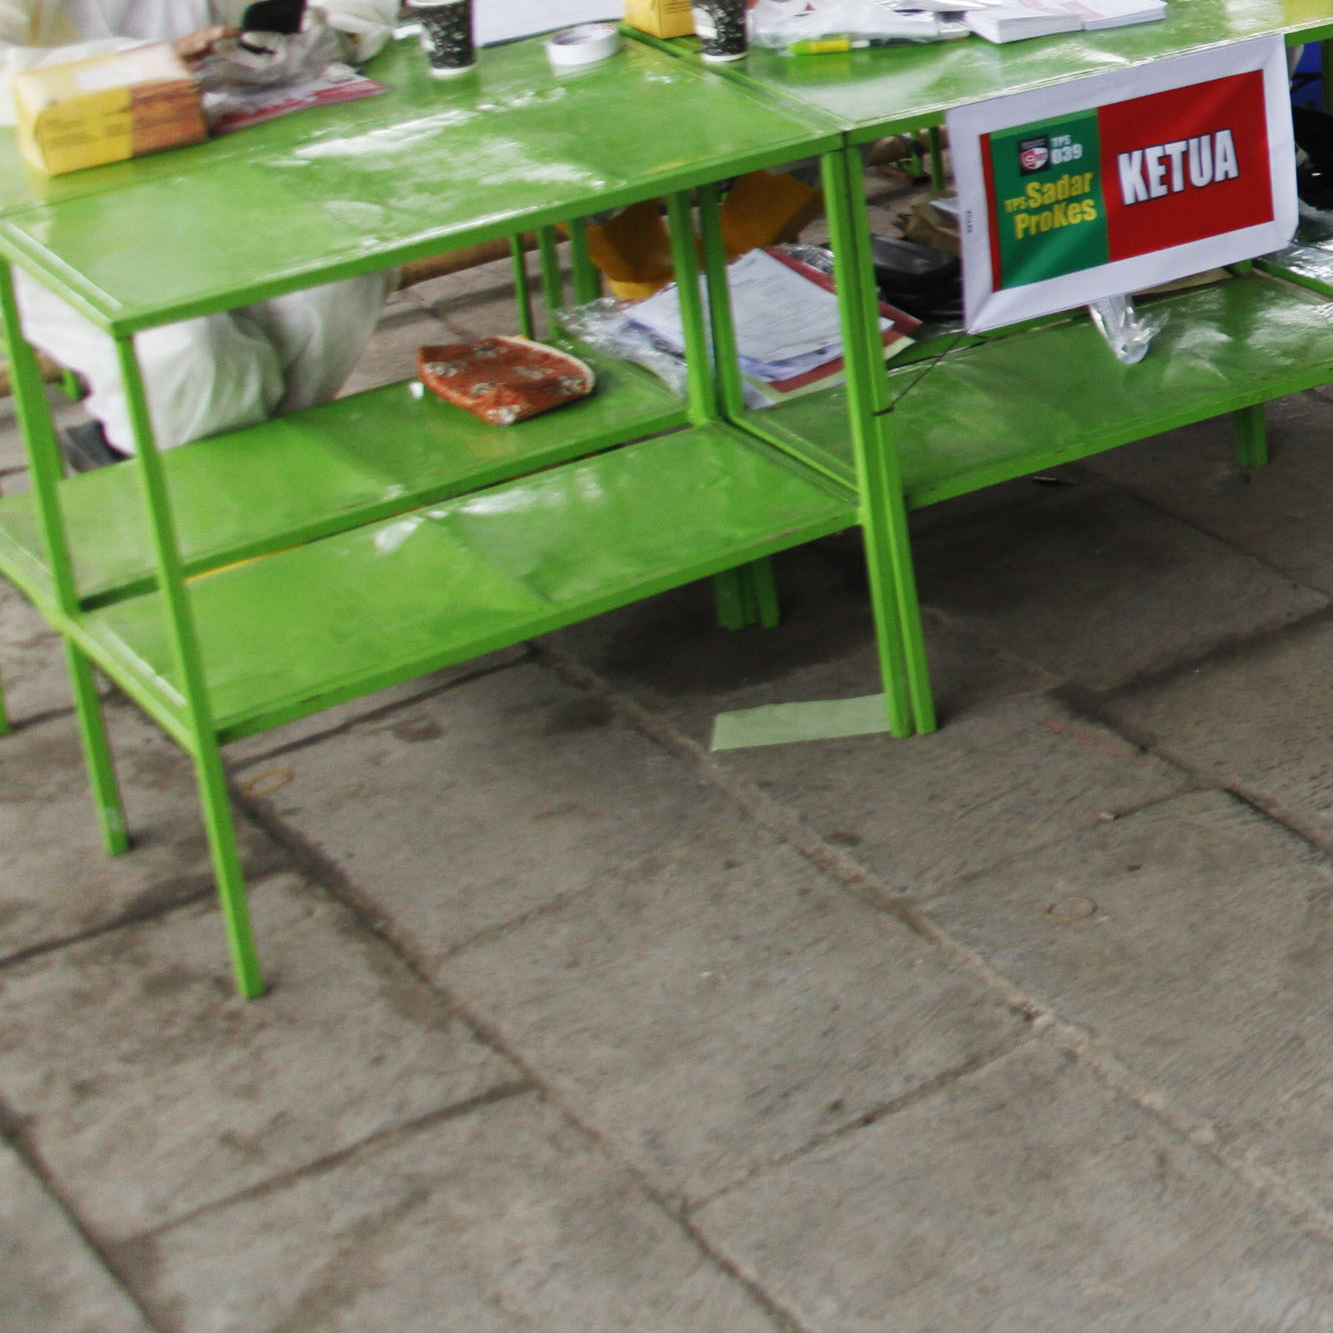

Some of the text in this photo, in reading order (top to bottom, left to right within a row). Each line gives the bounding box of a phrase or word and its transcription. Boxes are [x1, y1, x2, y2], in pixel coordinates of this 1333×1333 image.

[1050, 142, 1083, 165] 039
[1117, 129, 1239, 207] KETUA
[1026, 172, 1093, 209] Sadar
[1014, 198, 1098, 241] ProKes
